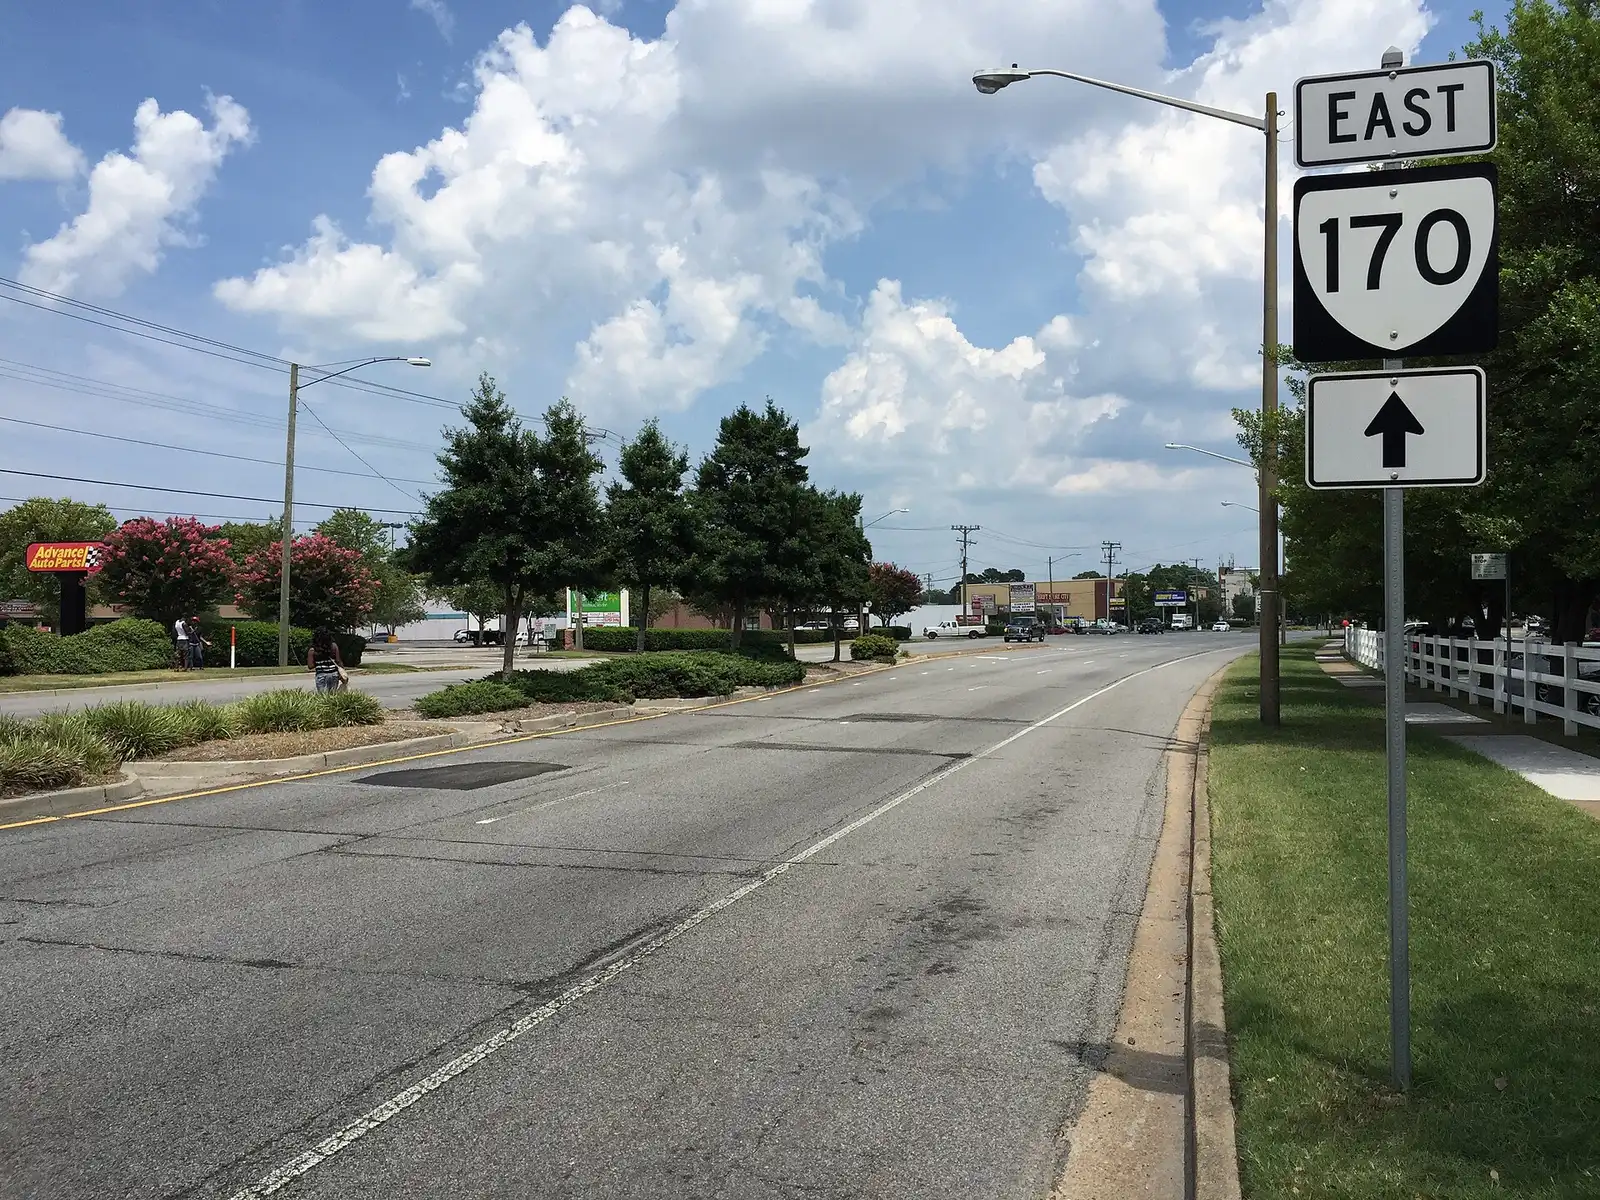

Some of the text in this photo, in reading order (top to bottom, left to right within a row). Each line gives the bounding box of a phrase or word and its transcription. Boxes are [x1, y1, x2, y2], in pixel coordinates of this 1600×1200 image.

[1328, 83, 1464, 144] EAST
[1319, 208, 1471, 293] 170
[29, 557, 82, 568] Auto Parts
[35, 546, 84, 559] Advance
